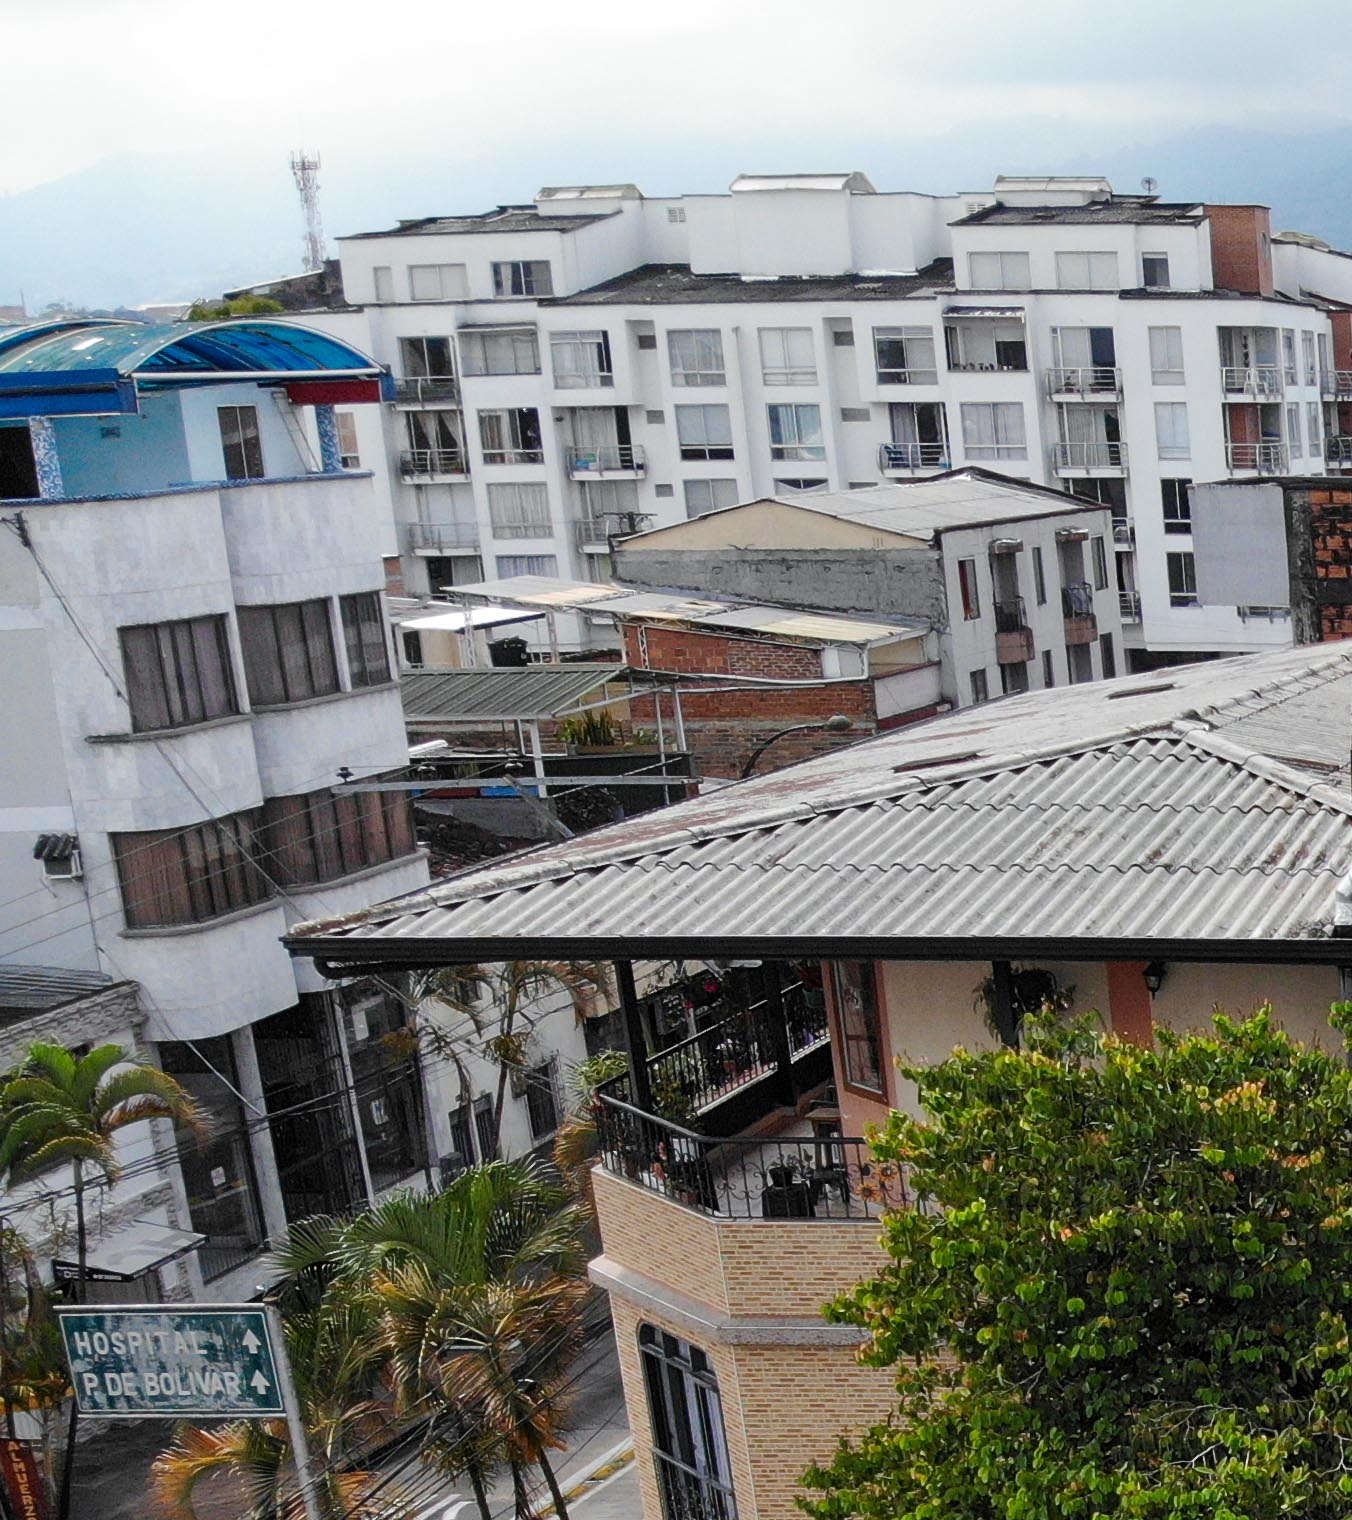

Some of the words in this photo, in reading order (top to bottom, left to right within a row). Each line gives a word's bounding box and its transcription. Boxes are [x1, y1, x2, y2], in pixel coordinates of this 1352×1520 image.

[73, 1331, 207, 1356] HOSPITAL
[105, 1372, 138, 1396] DE
[143, 1371, 241, 1397] BOLIVAR
